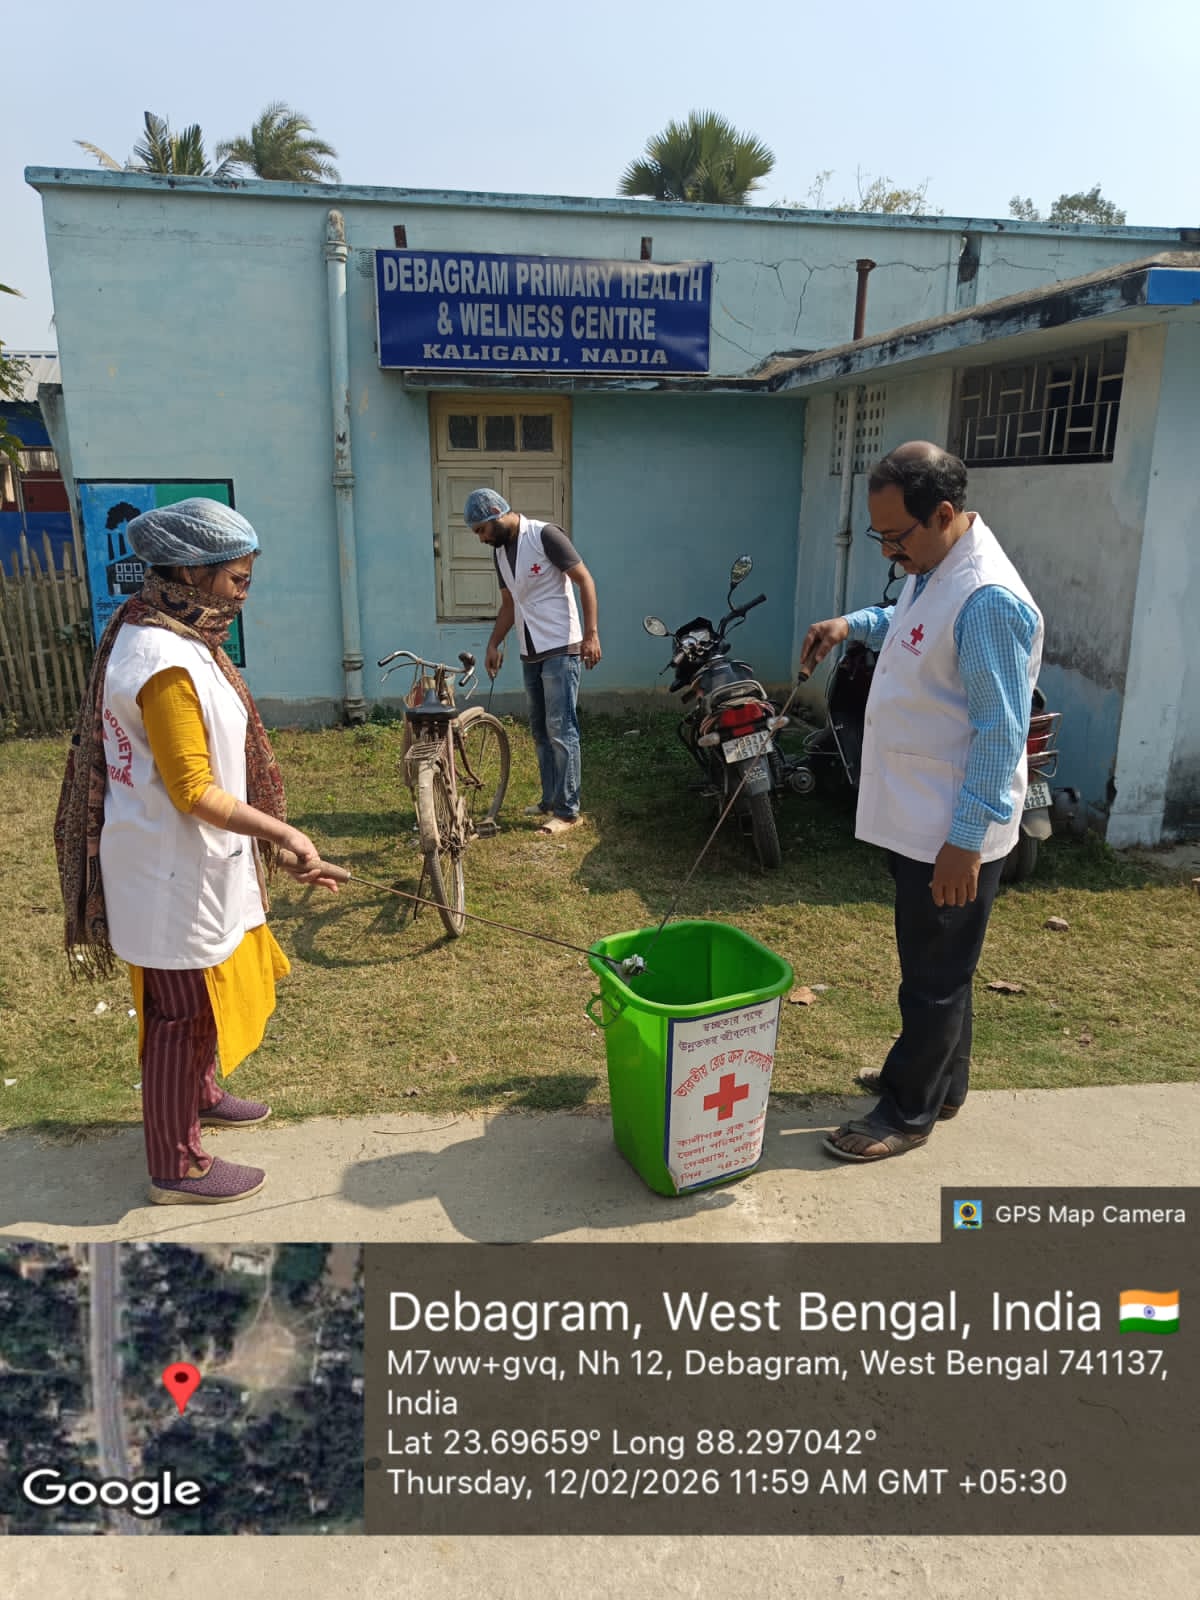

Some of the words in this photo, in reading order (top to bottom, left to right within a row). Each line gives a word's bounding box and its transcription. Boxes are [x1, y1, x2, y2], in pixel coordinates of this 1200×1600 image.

[383, 257, 509, 295] DEBAGRAM
[516, 262, 614, 298] PRIMARY
[621, 266, 702, 301] HEALTH
[437, 301, 452, 335] &
[459, 302, 564, 339] WELNESS
[571, 306, 656, 341] CENTRE
[581, 348, 668, 364] NADIA
